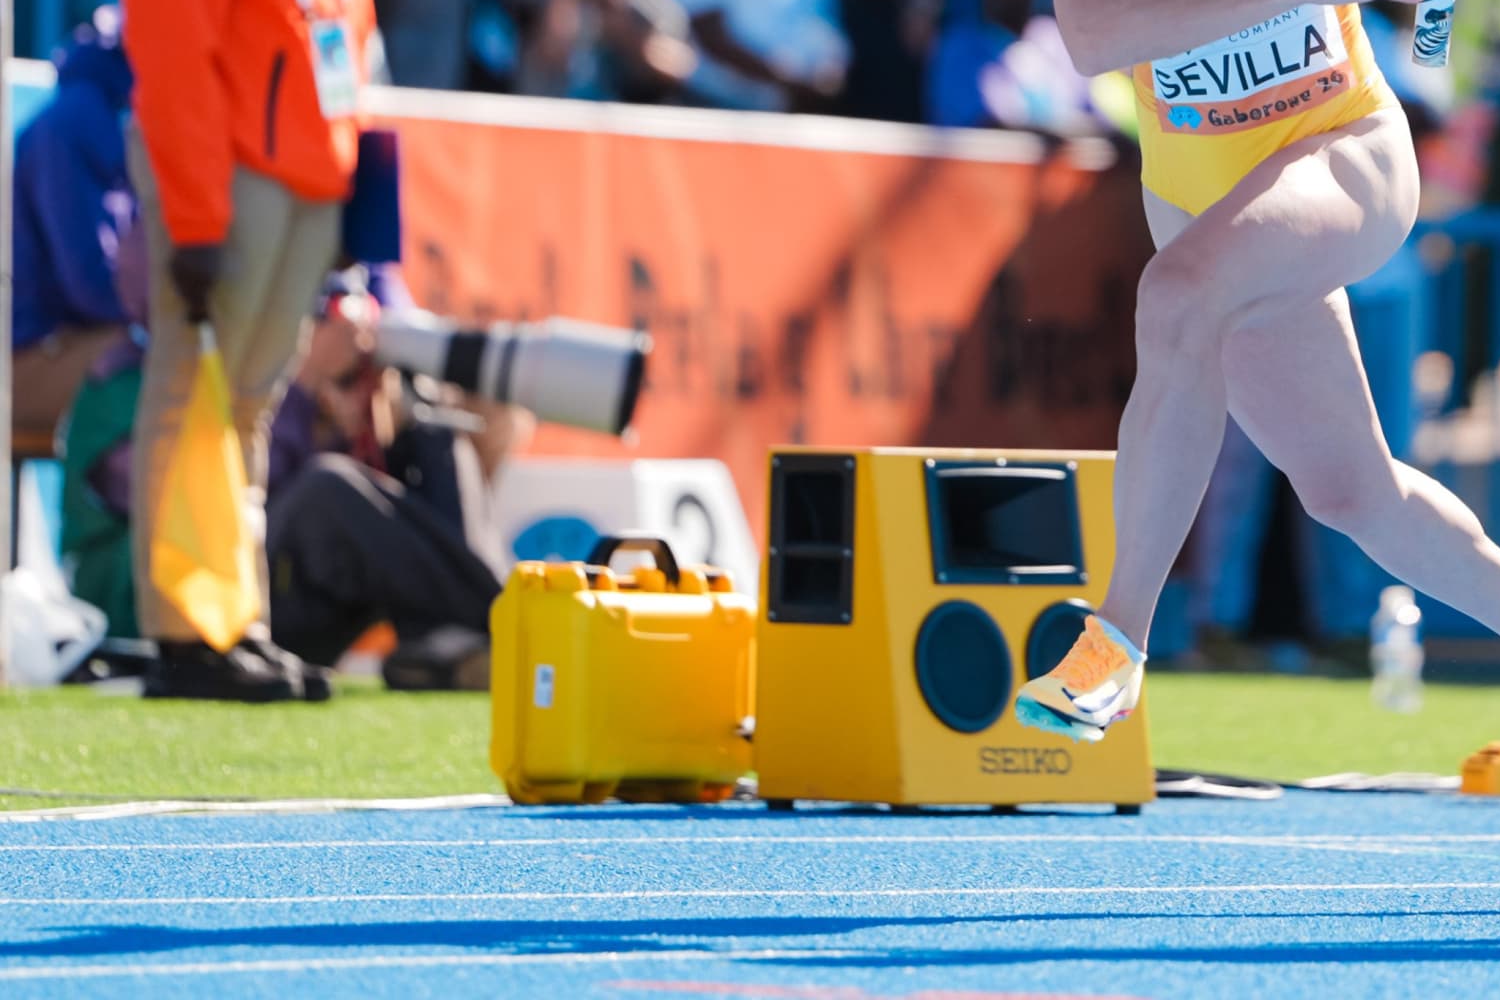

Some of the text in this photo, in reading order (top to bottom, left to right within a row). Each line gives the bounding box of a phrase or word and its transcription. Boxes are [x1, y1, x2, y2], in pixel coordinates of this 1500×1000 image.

[1228, 7, 1300, 43] COMPANY
[1155, 24, 1334, 99] SEVILLA
[979, 746, 1073, 776] SEIKO
